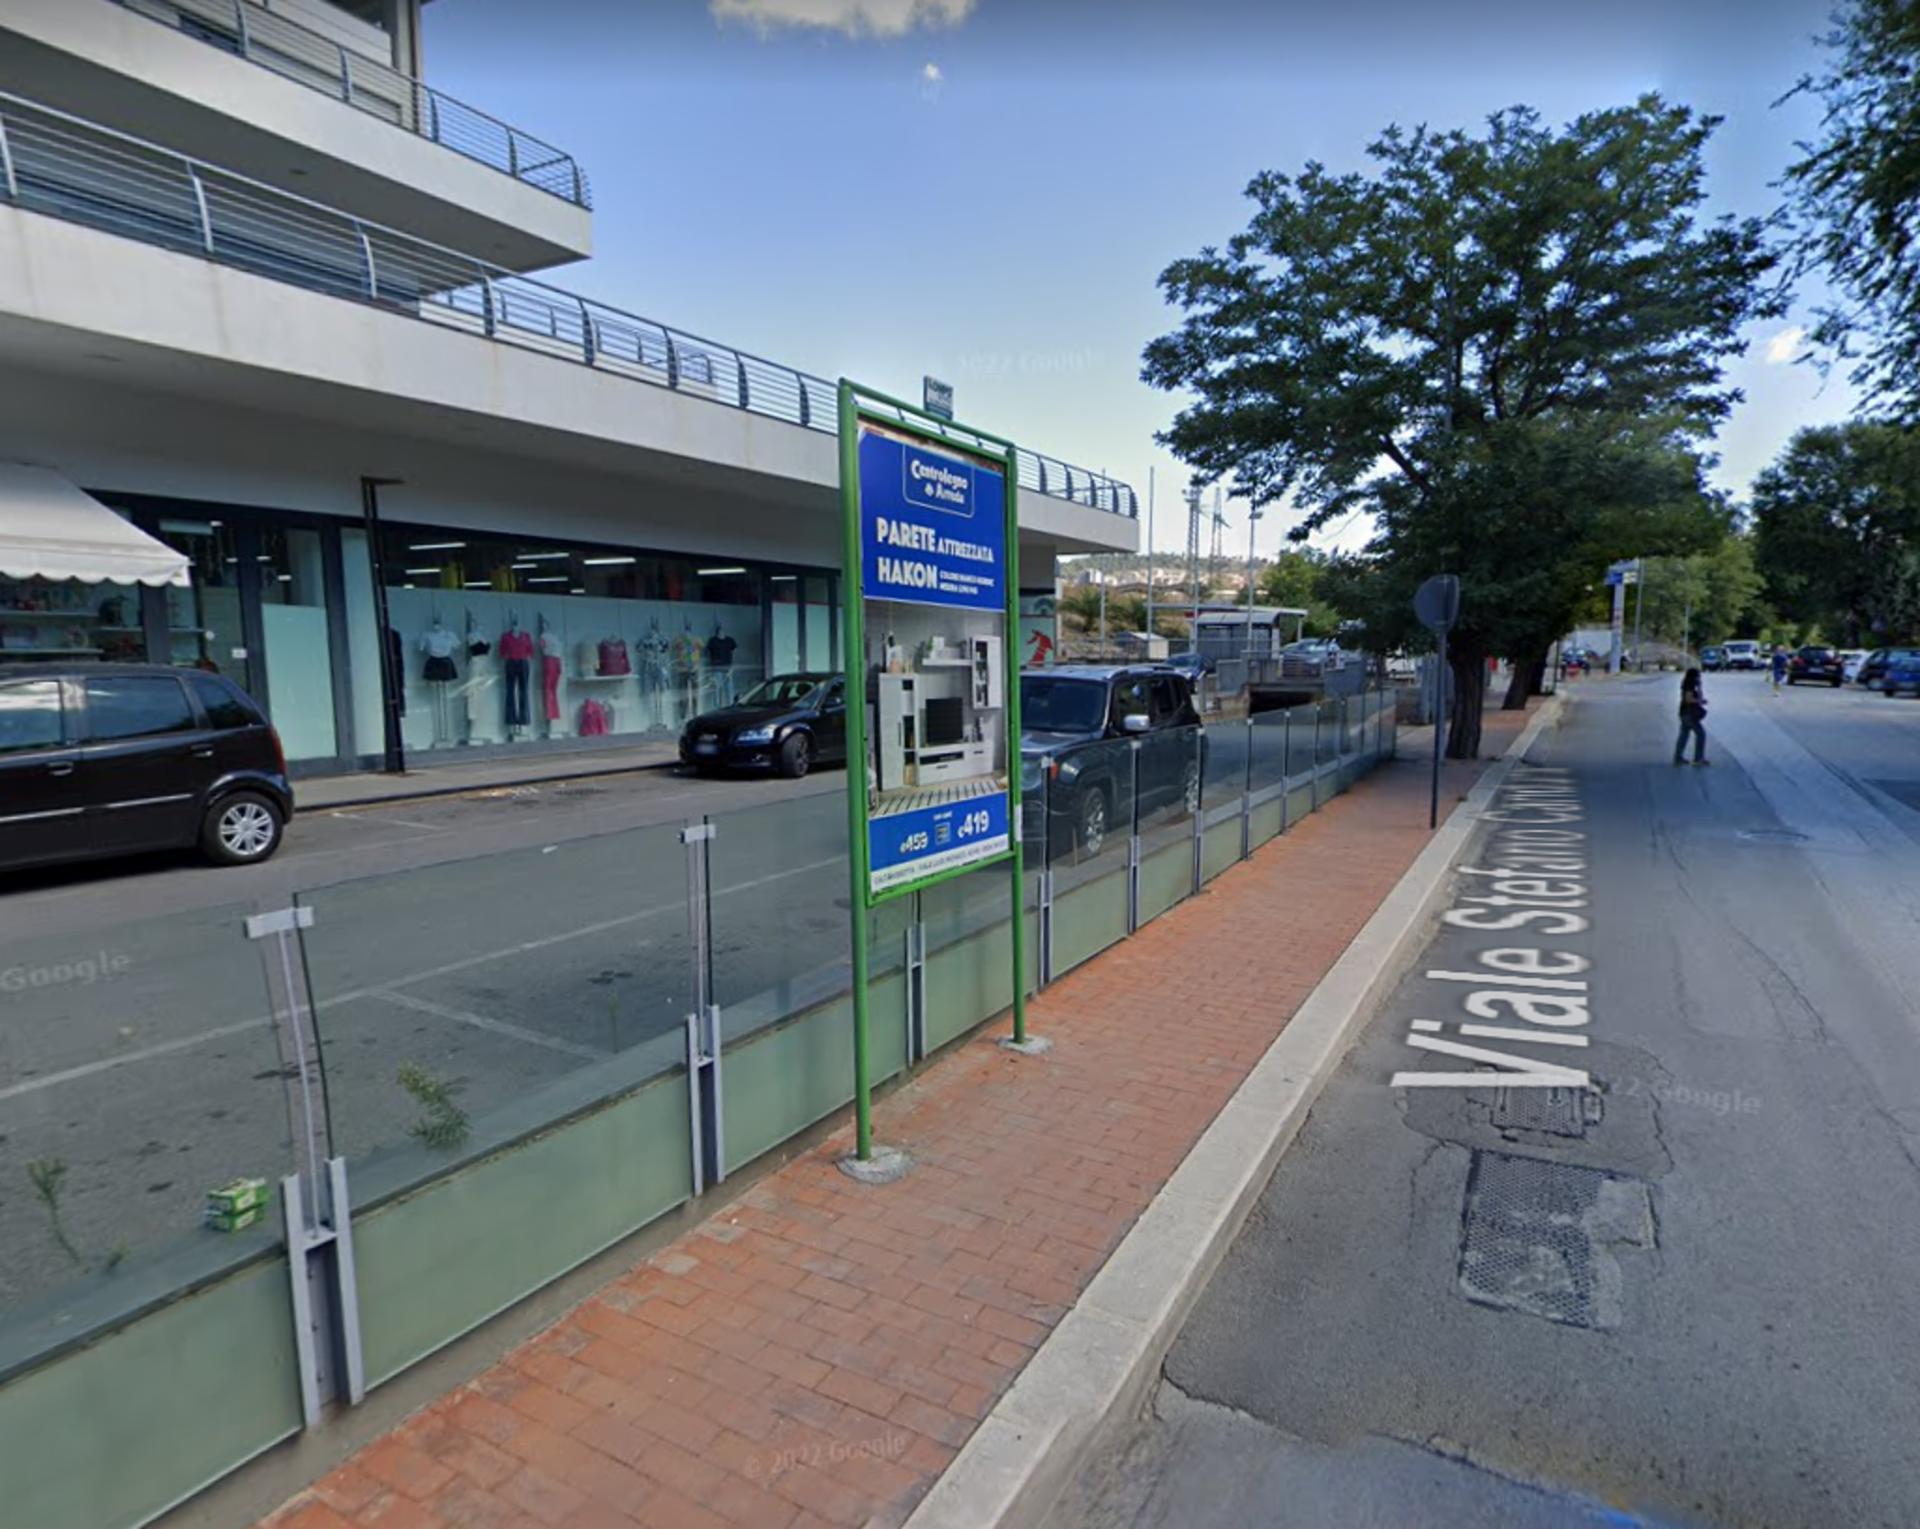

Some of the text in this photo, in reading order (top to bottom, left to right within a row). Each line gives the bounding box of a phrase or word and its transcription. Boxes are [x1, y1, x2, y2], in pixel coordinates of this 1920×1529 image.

[876, 517, 994, 563] PARETE ATTREZZATA
[877, 557, 938, 589] HAKON
